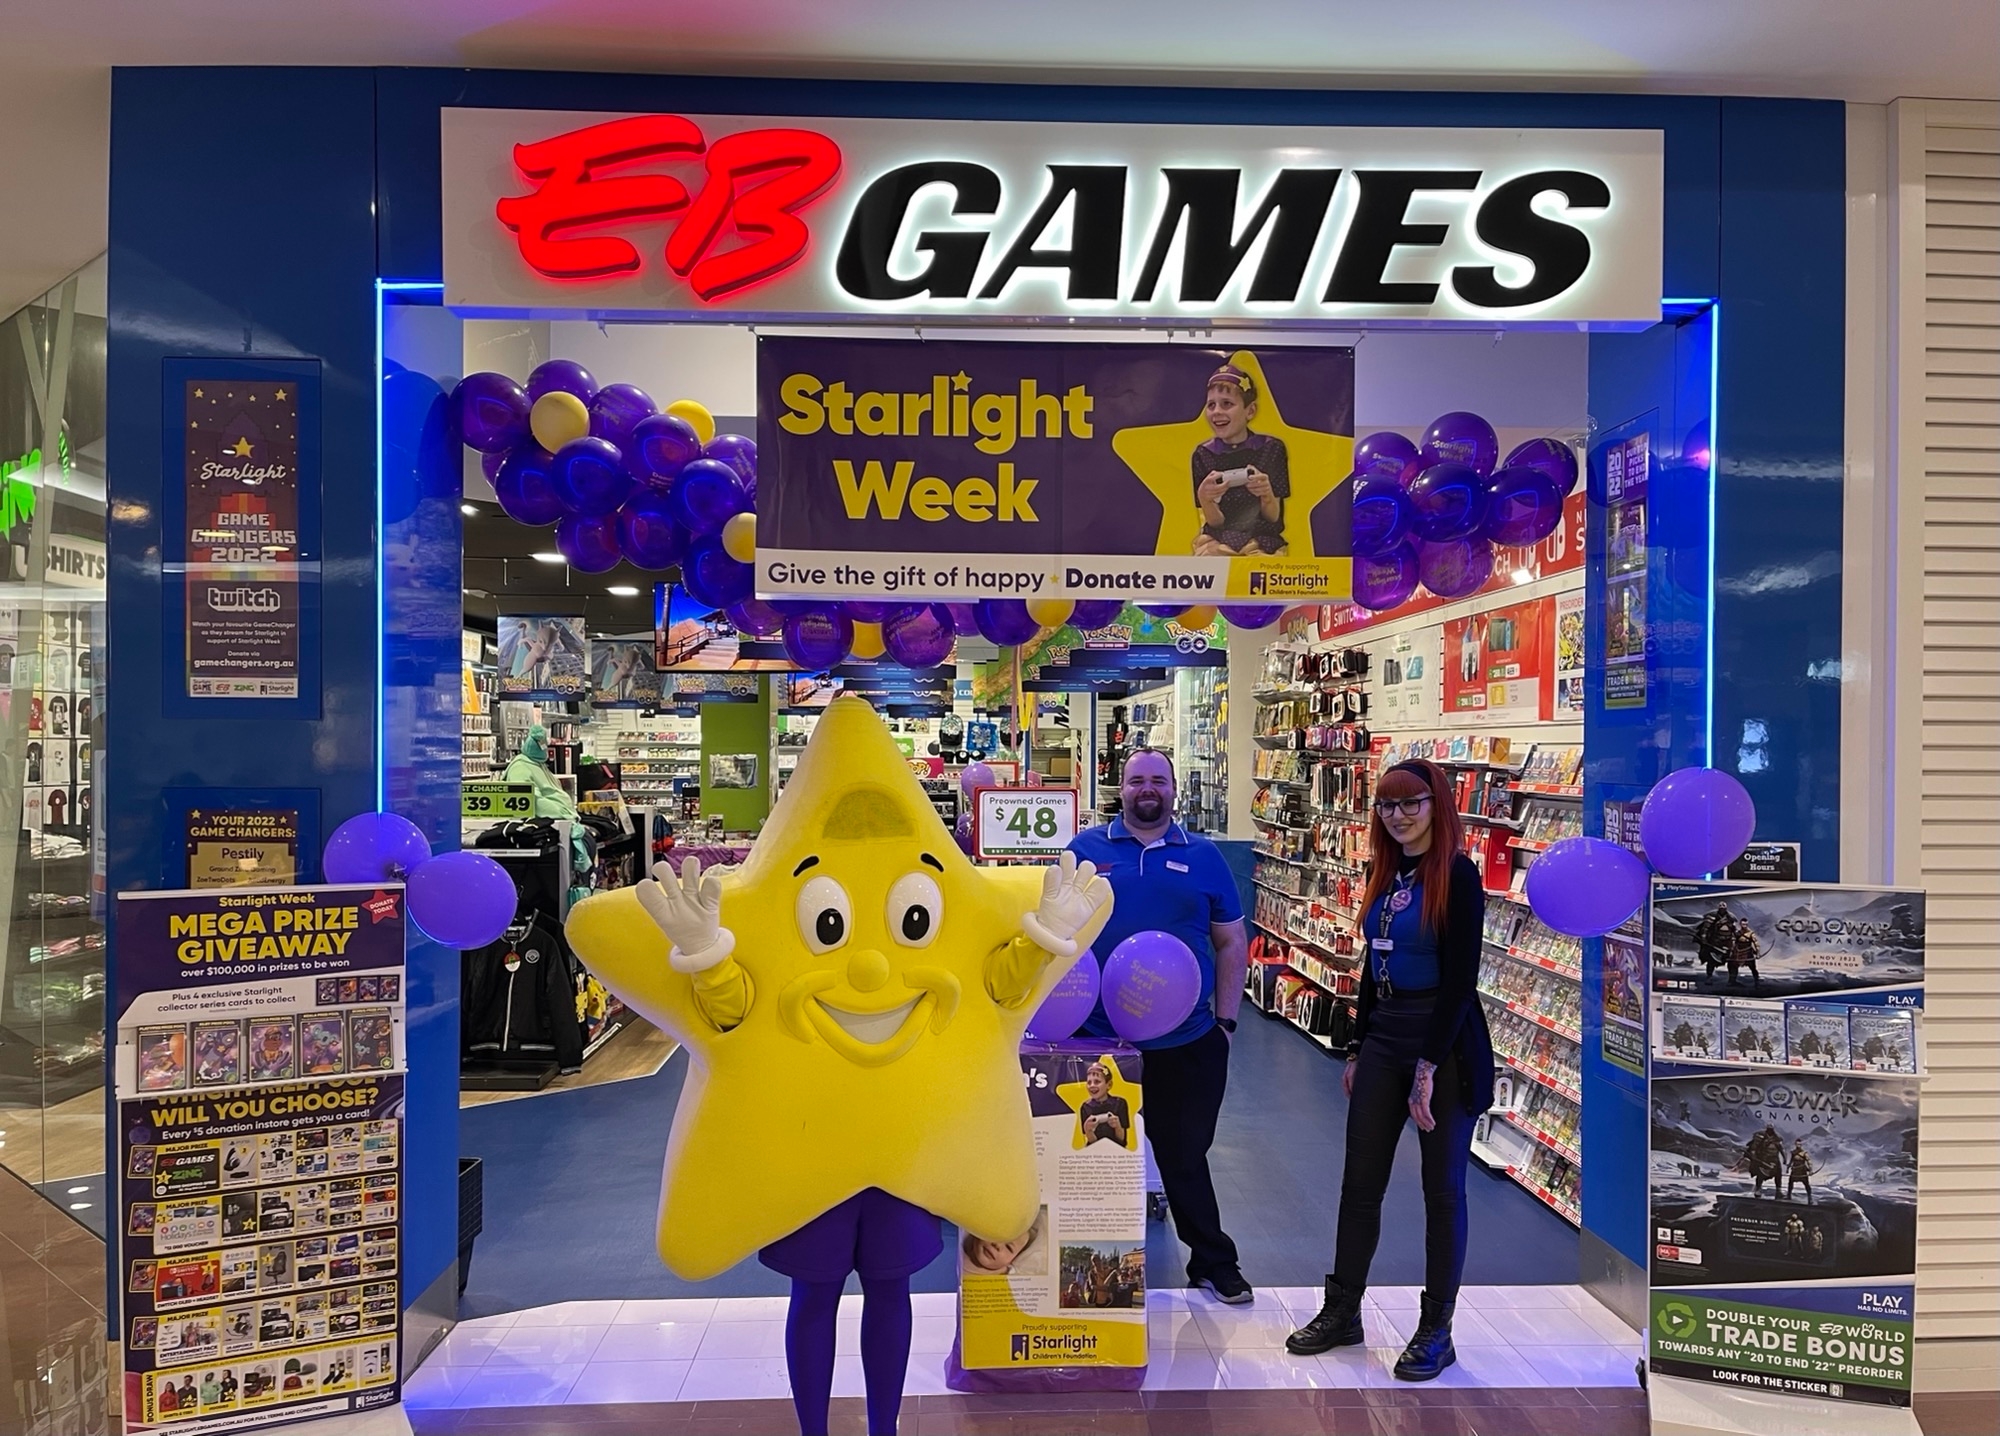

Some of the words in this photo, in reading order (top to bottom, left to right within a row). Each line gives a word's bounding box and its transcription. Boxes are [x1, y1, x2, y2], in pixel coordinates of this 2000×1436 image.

[496, 114, 843, 303] EB
[836, 160, 1612, 309] GAMES
[778, 371, 1094, 455] Starlight
[200, 462, 287, 485] Starlight
[832, 460, 1040, 523] Week
[217, 513, 270, 525] GAME
[210, 547, 276, 562] 2022
[767, 561, 829, 588] Give
[833, 564, 880, 588] the
[883, 564, 930, 595] gift
[933, 564, 960, 588] of
[964, 565, 1045, 593] happy
[1065, 568, 1157, 591] Donate
[1162, 573, 1215, 590] now
[1268, 573, 1329, 589] Starlight
[208, 587, 280, 612] twitch
[194, 659, 294, 669] gamechangers.org.au
[472, 785, 509, 793] CHANCE
[989, 797, 1034, 806] Preowned
[1036, 797, 1068, 806] Games
[212, 816, 245, 826] YOUR
[247, 816, 275, 826] 2022
[995, 807, 1059, 838] $48
[190, 827, 225, 837] GAME
[227, 827, 296, 838] CHANGERS:
[221, 848, 265, 862] Pestily
[1743, 851, 1781, 862] Opening
[1749, 863, 1775, 871] Hours
[1667, 884, 1699, 892] PlayStation
[219, 895, 277, 908] Starlight
[279, 893, 315, 905] Week
[169, 912, 267, 939] MEGA
[274, 906, 359, 931] PRIZE
[1775, 918, 1823, 937] GOD
[176, 932, 352, 965] GIVEAWAY
[181, 968, 204, 978] over
[206, 964, 255, 977] $100,000
[257, 963, 268, 973] in
[269, 962, 299, 974] prizes
[301, 961, 312, 970] to
[314, 960, 327, 970] be
[329, 959, 350, 968] won
[172, 992, 190, 1001] Plus
[201, 989, 242, 1000] exclusive
[244, 986, 283, 999] Starlight
[1887, 995, 1917, 1005] PLAY
[157, 1001, 198, 1012] collector
[199, 1000, 226, 1010] series
[227, 998, 253, 1008] cards
[255, 997, 265, 1006] to
[266, 995, 296, 1005] collect
[151, 1105, 210, 1127] WILL
[214, 1099, 266, 1121] YOU
[269, 1087, 379, 1114] CHOOSE?
[1701, 1082, 1765, 1109] GOD
[1793, 1088, 1861, 1118] WAR
[162, 1130, 192, 1140] Every
[193, 1127, 204, 1136] $5
[205, 1123, 254, 1135] donation
[255, 1119, 290, 1130] instore
[291, 1116, 314, 1128] gets
[315, 1114, 334, 1125] you
[344, 1109, 370, 1120] card!
[165, 1145, 190, 1153] MAJOR
[1857, 1304, 1872, 1312] HAS
[1872, 1305, 1884, 1313] NO
[1862, 1293, 1903, 1308] PLAY
[1021, 1324, 1049, 1332] Proudly
[1049, 1323, 1088, 1332] supporting
[1706, 1308, 1766, 1326] DOUBLE
[1768, 1316, 1811, 1332] YOUR
[1819, 1323, 1844, 1336] EB
[1032, 1335, 1098, 1353] Starlight
[1706, 1322, 1798, 1353] TRADE
[1806, 1336, 1906, 1366] BONUS
[1657, 1339, 1715, 1357] TOWARDS
[1716, 1348, 1741, 1360] ANY
[1766, 1354, 1782, 1366] TO
[1784, 1356, 1809, 1369] END
[1838, 1364, 1904, 1381] PREORDER
[146, 1374, 154, 1396] DRAW
[1712, 1369, 1740, 1382] LOOK
[1741, 1373, 1761, 1385] FOR
[1763, 1376, 1784, 1388] THE
[1784, 1379, 1828, 1394] STICKER
[146, 1396, 154, 1422] BONUS
